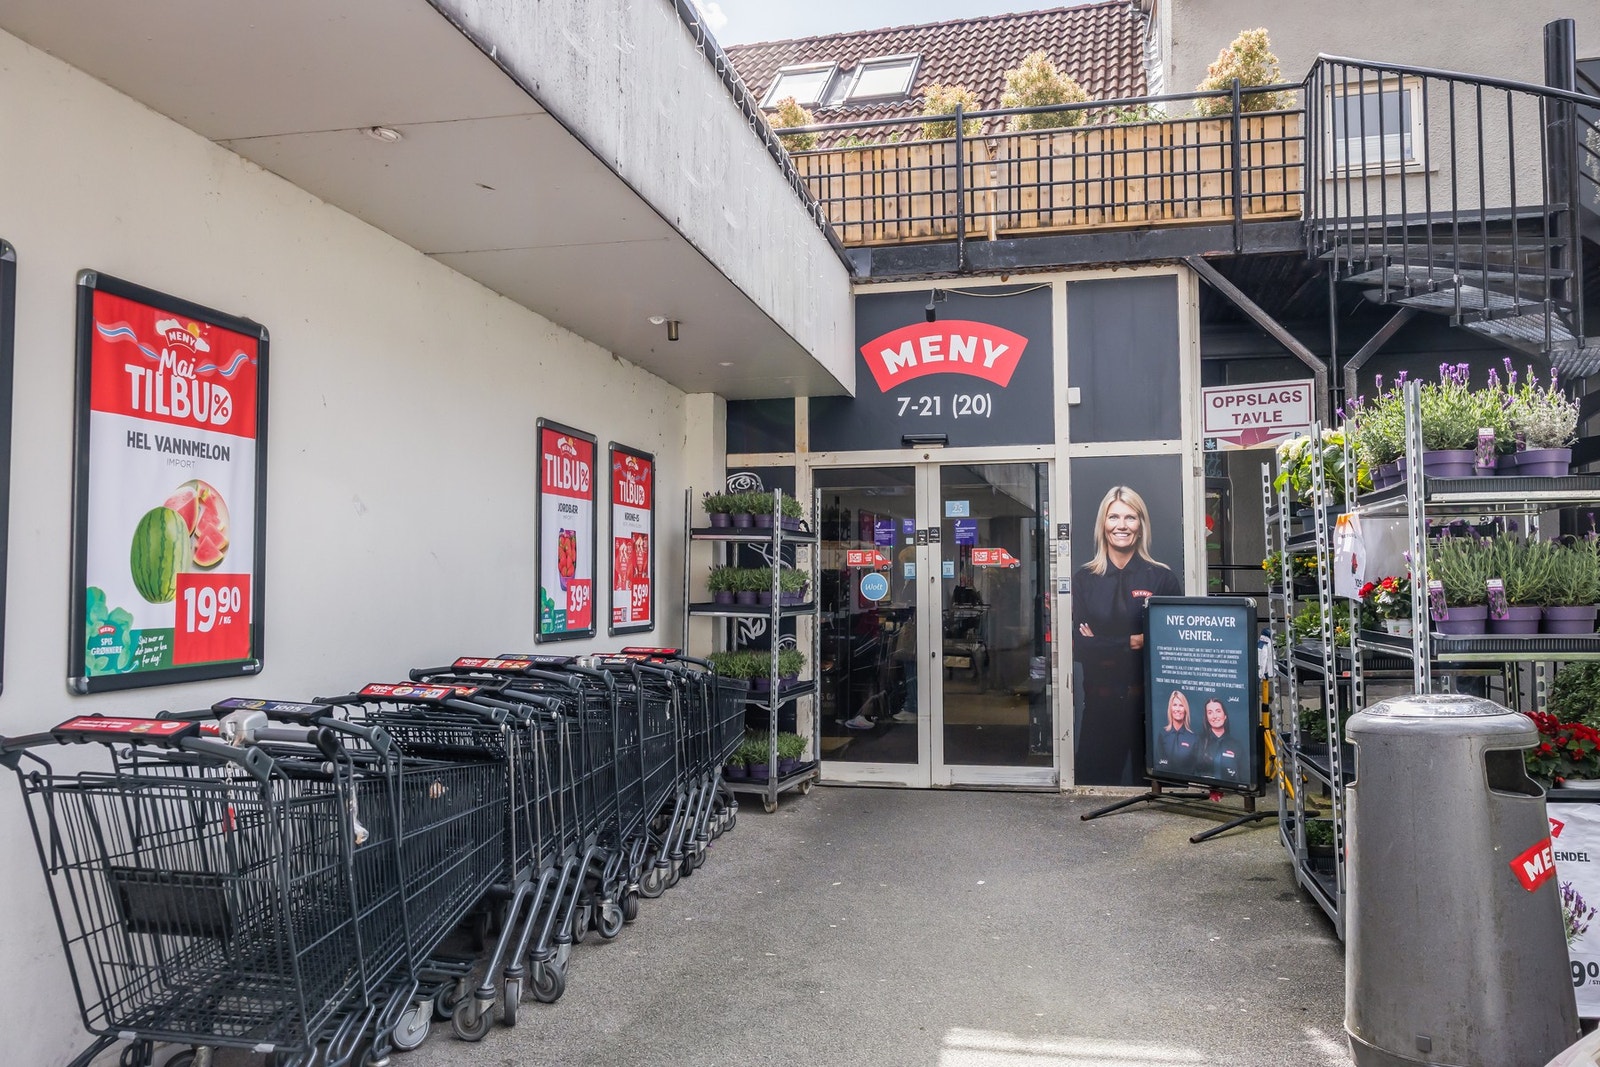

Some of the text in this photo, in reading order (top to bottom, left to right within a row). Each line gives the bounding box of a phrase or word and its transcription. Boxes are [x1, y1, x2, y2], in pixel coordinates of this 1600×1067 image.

[168, 331, 196, 347] MENY
[880, 334, 1010, 376] MENY
[158, 347, 197, 380] Mai
[897, 392, 992, 419] 7-21 (20)
[1212, 390, 1303, 409] OPPSLAGS
[1231, 410, 1283, 425] TAVLE
[126, 430, 231, 462] HEL VANNMELON
[166, 458, 196, 469] IMPORT
[864, 582, 884, 591] Wolt
[1166, 614, 1236, 628] NYE OPPGAVER
[100, 637, 113, 646] SPIS
[1178, 629, 1223, 642] VENTER...
[1522, 845, 1555, 882] ME
[1554, 851, 1591, 862] ENDEL
